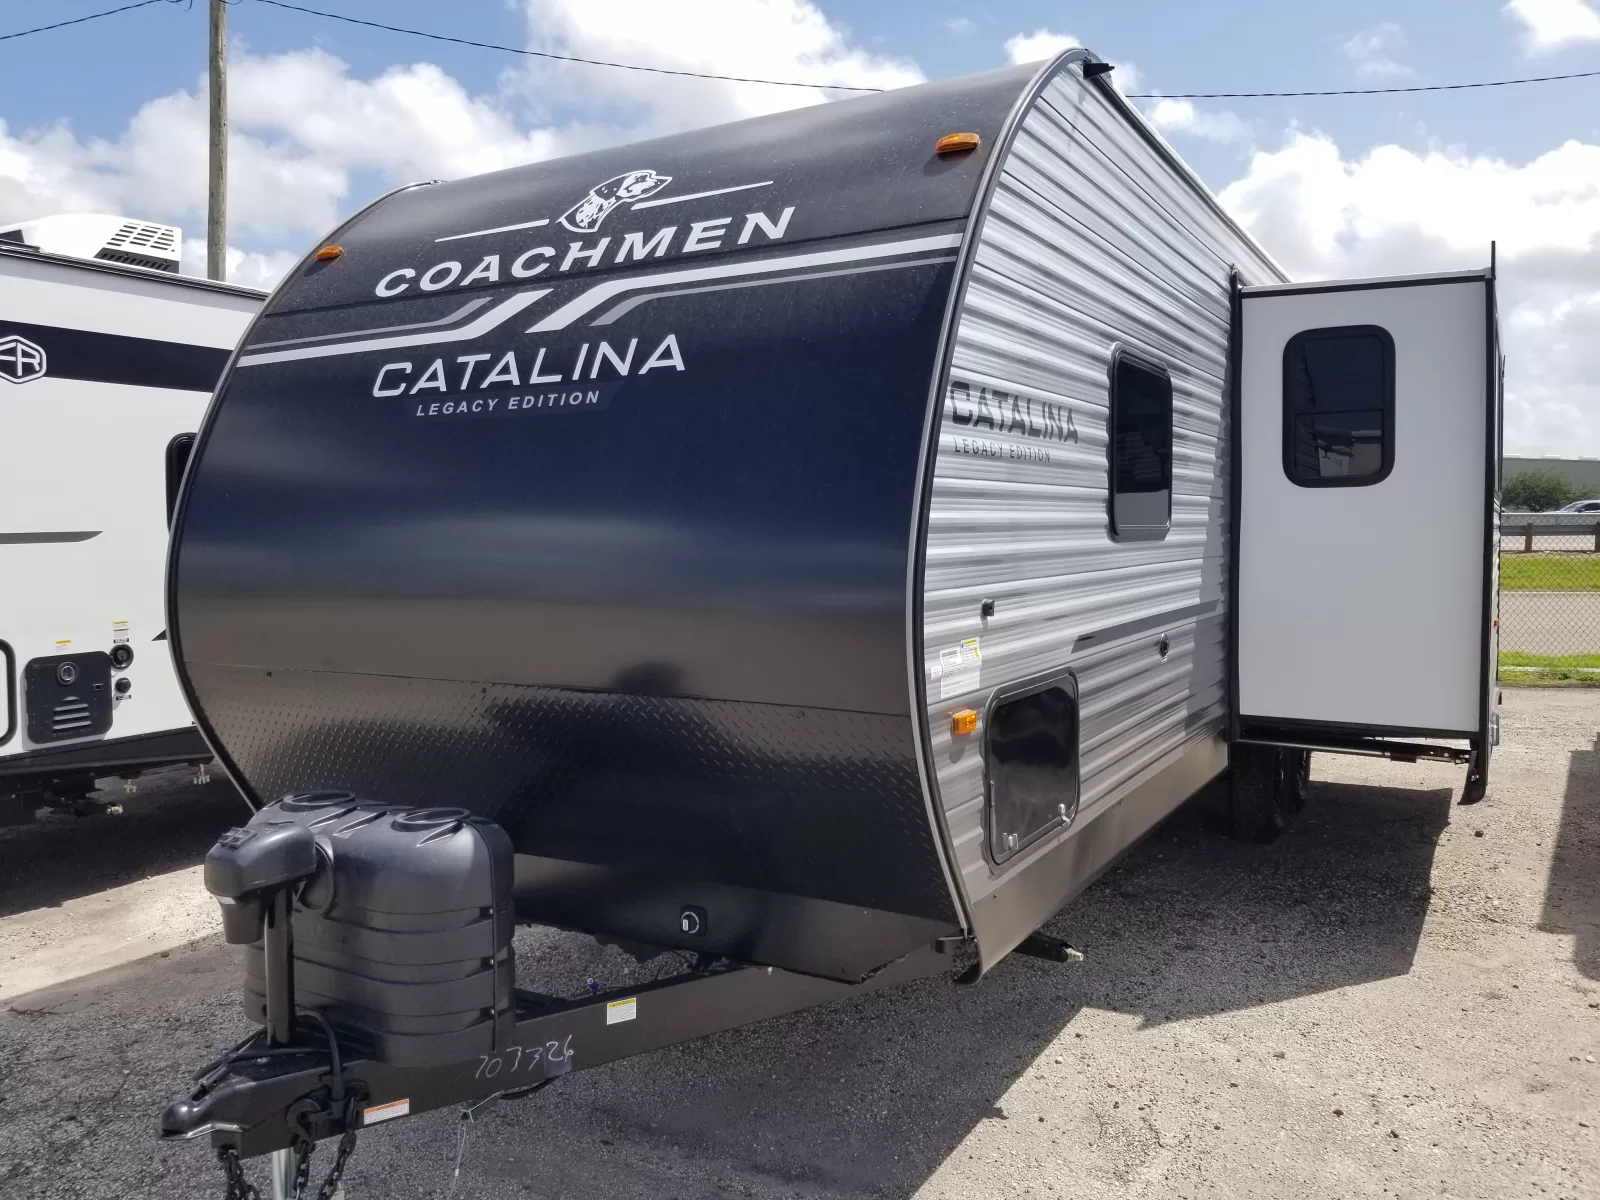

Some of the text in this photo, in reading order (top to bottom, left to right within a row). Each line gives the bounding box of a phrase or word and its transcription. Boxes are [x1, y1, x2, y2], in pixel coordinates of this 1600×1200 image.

[375, 206, 796, 298] COACHMEN
[372, 334, 686, 398] CATALINA
[416, 390, 600, 417] LEGACY EDITION
[950, 380, 1079, 444] CATALINA
[953, 437, 1051, 463] LEGACY EDITION
